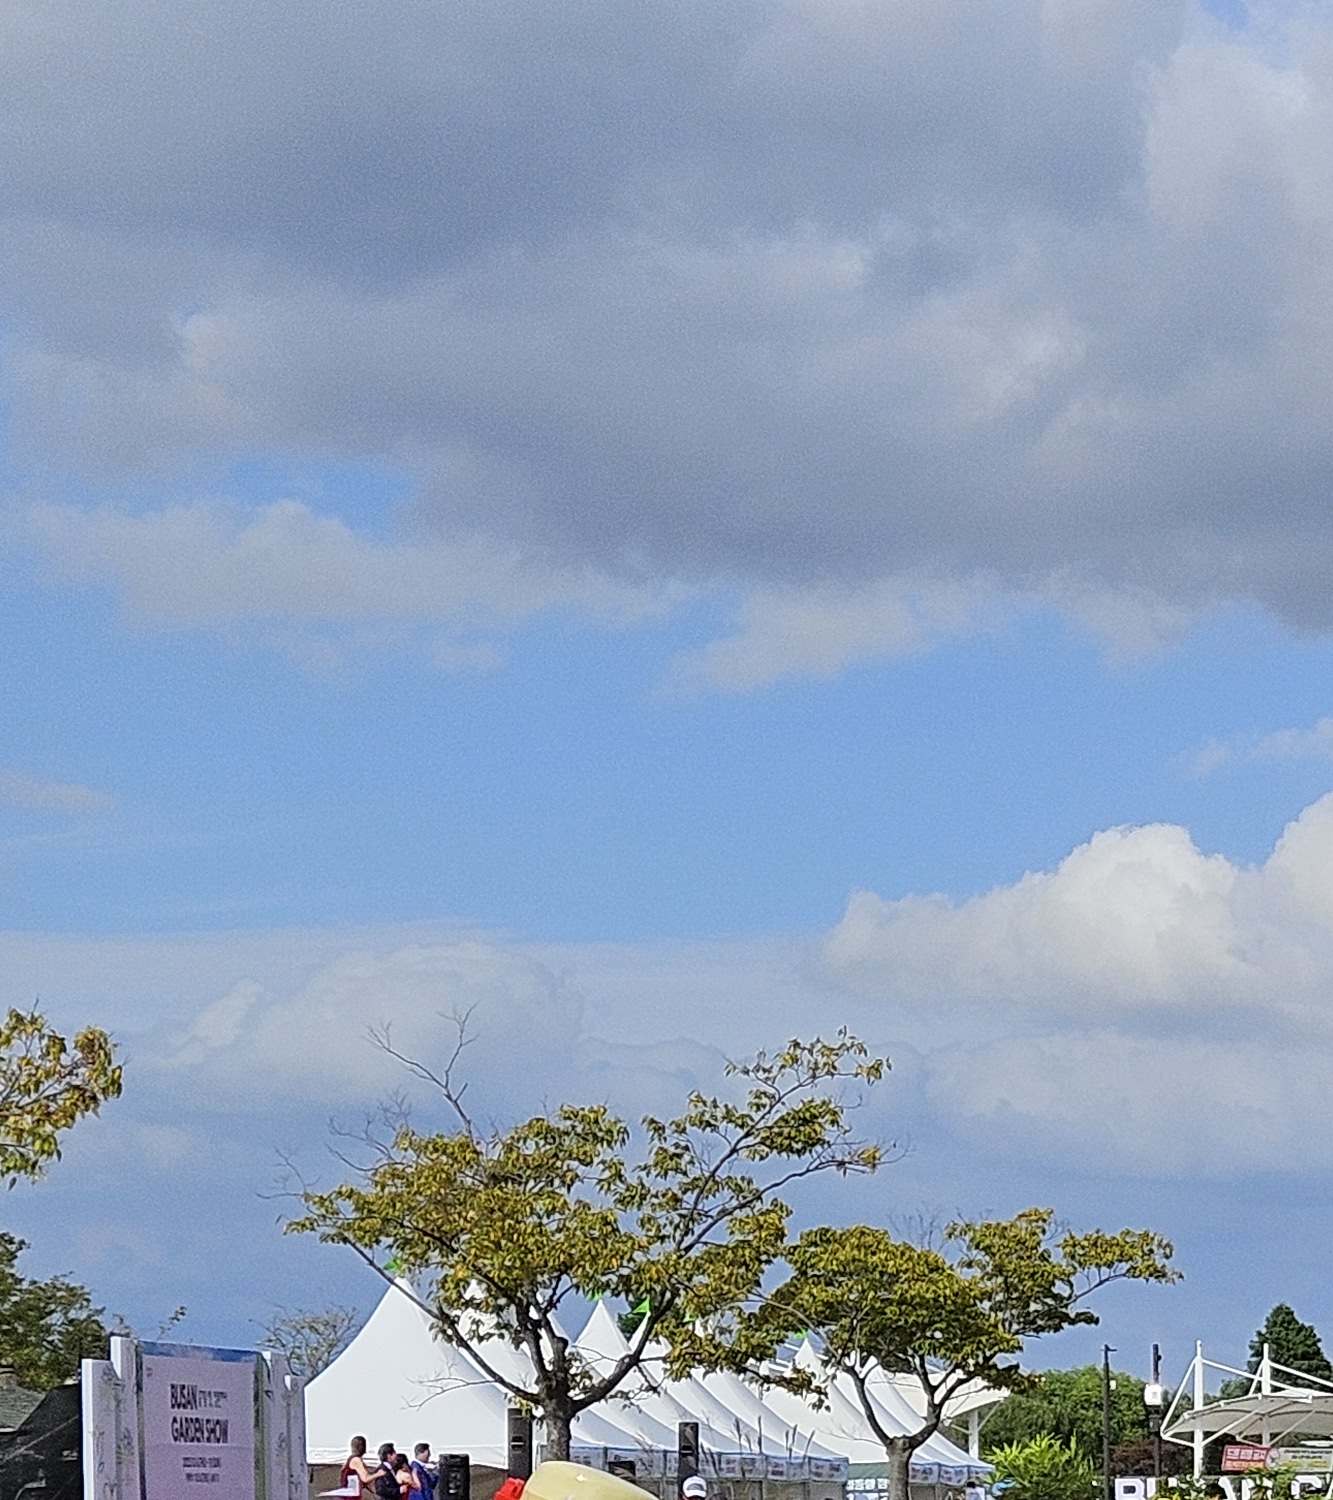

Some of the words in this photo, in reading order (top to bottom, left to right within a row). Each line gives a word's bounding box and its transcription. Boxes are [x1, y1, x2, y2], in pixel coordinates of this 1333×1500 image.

[170, 1383, 198, 1410] BUSAN
[171, 1416, 204, 1443] GARDEN
[205, 1419, 228, 1444] SHOW
